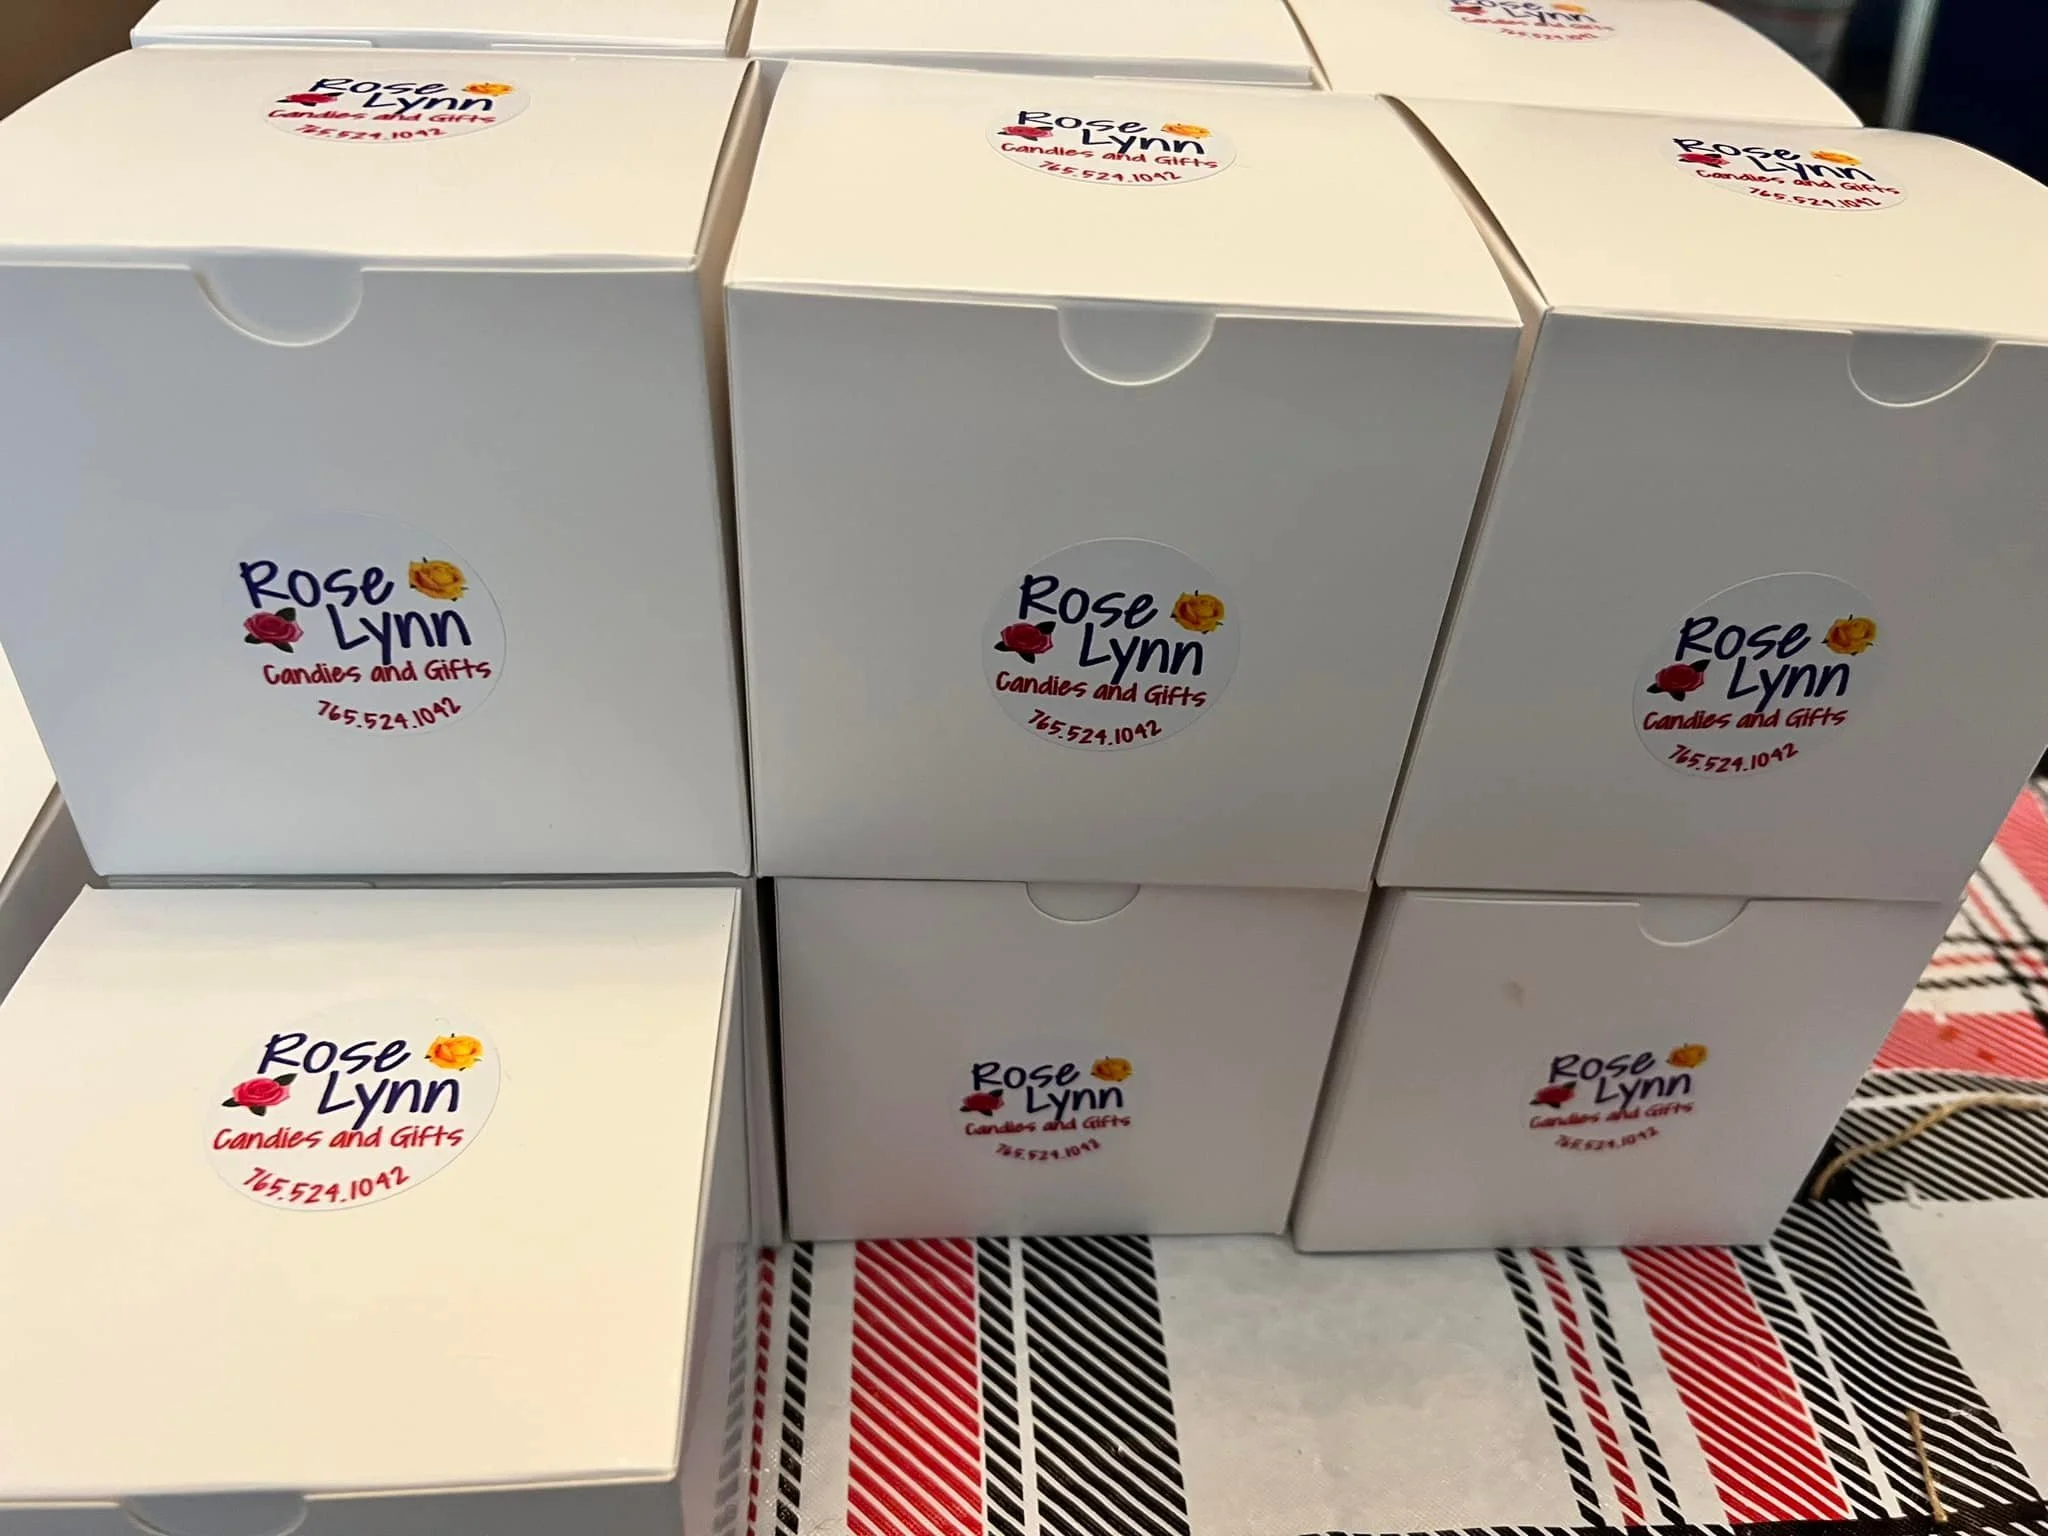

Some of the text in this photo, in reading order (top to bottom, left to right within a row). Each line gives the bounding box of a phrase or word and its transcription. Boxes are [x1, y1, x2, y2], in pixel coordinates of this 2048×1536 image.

[1502, 7, 1597, 24] Lynn
[309, 78, 448, 94] Rose
[268, 110, 496, 123] Candies and Gifts
[362, 93, 493, 113] Lynn
[296, 124, 447, 139] 765.524.1042
[1018, 111, 1147, 133] Rose
[1001, 143, 1218, 168] Candies and Gifts
[1082, 129, 1205, 155] Lynn
[1673, 138, 1800, 160] Rose
[1039, 160, 1182, 182] 765.524.1042
[1749, 156, 1875, 181] Lynn
[1696, 170, 1900, 195] Candies and Gifts
[1749, 187, 1881, 208] 765.524.1042
[239, 560, 395, 608] Rose
[1019, 574, 1158, 629] Rose
[326, 603, 471, 665] Lynn
[1675, 616, 1811, 661] Rose
[1079, 622, 1203, 685] Lynn
[263, 658, 492, 685] Candies and Gifts
[1727, 656, 1849, 713] Lynn
[996, 671, 1207, 707] Candies and Gifts
[317, 697, 461, 730] 765.524.1042
[1028, 708, 1161, 745] 765.524.1042
[1643, 706, 1848, 730] Candies and Gifts
[1668, 743, 1799, 773] 765.524.1042
[257, 1032, 411, 1074] Rose
[971, 1062, 1080, 1090] Rose
[1549, 1052, 1656, 1083] Rose
[317, 1070, 460, 1131] Lynn
[1027, 1086, 1123, 1121] Lynn
[1594, 1073, 1691, 1110] Lynn
[965, 1115, 1132, 1135] Candies and Gifts
[1529, 1102, 1695, 1129] Candies and Gifts
[213, 1125, 464, 1150] Candies and Gifts
[244, 1166, 410, 1203] 765.524.1042
